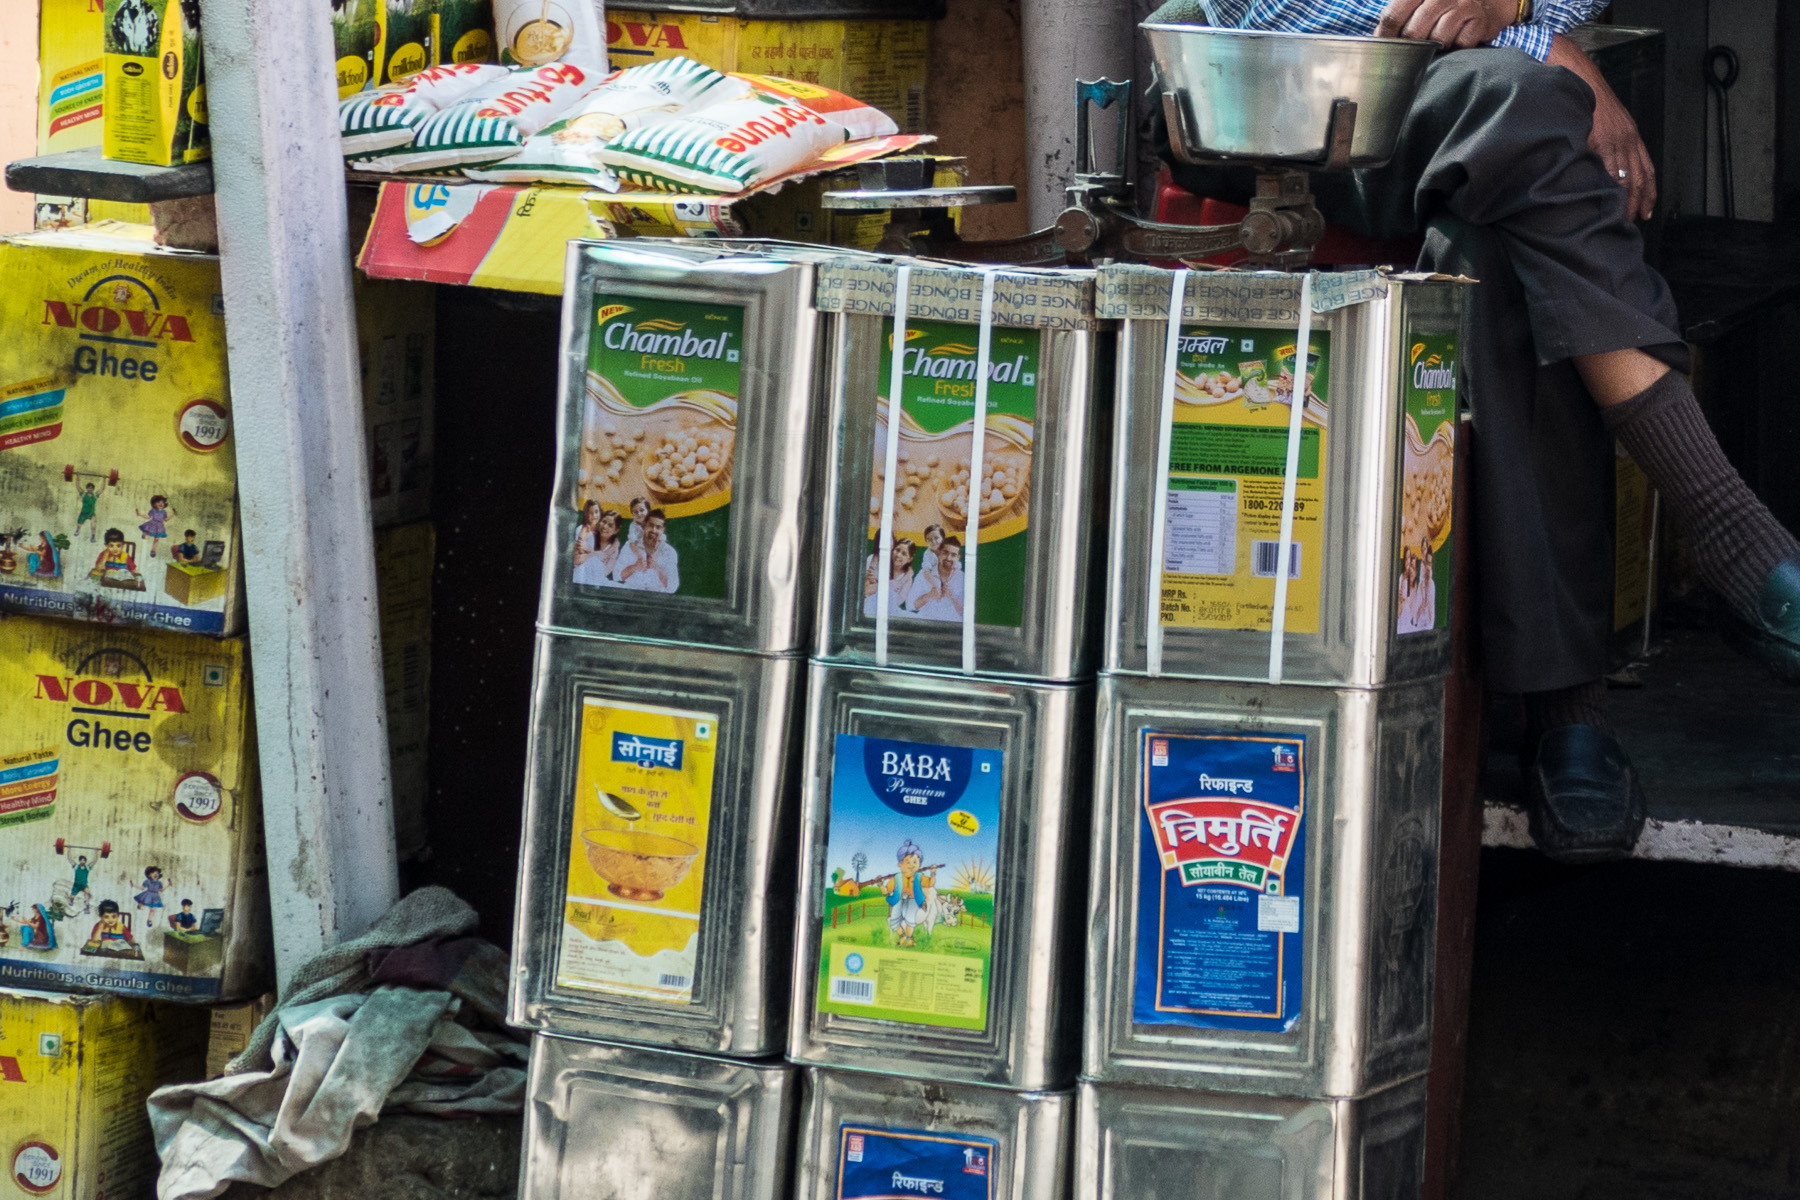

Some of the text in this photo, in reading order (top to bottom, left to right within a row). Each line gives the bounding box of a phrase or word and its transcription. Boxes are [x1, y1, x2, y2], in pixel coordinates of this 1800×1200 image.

[42, 300, 196, 342] NOVA
[604, 322, 728, 361] Chambal
[74, 346, 158, 381] Ghee
[641, 355, 685, 373] Fresh
[1413, 358, 1453, 391] Chambal
[193, 425, 222, 439] 1991
[1169, 462, 1281, 477] FREE FROM ARGEMONE
[34, 675, 188, 714] NOVA
[67, 719, 152, 753] Ghee
[618, 739, 677, 763] सोनाई
[882, 750, 952, 783] BABA
[189, 796, 216, 811] 1991
[886, 778, 946, 798] Premium
[903, 795, 928, 806] GHEE
[1, 964, 192, 995] Nutritious Granular Ghee
